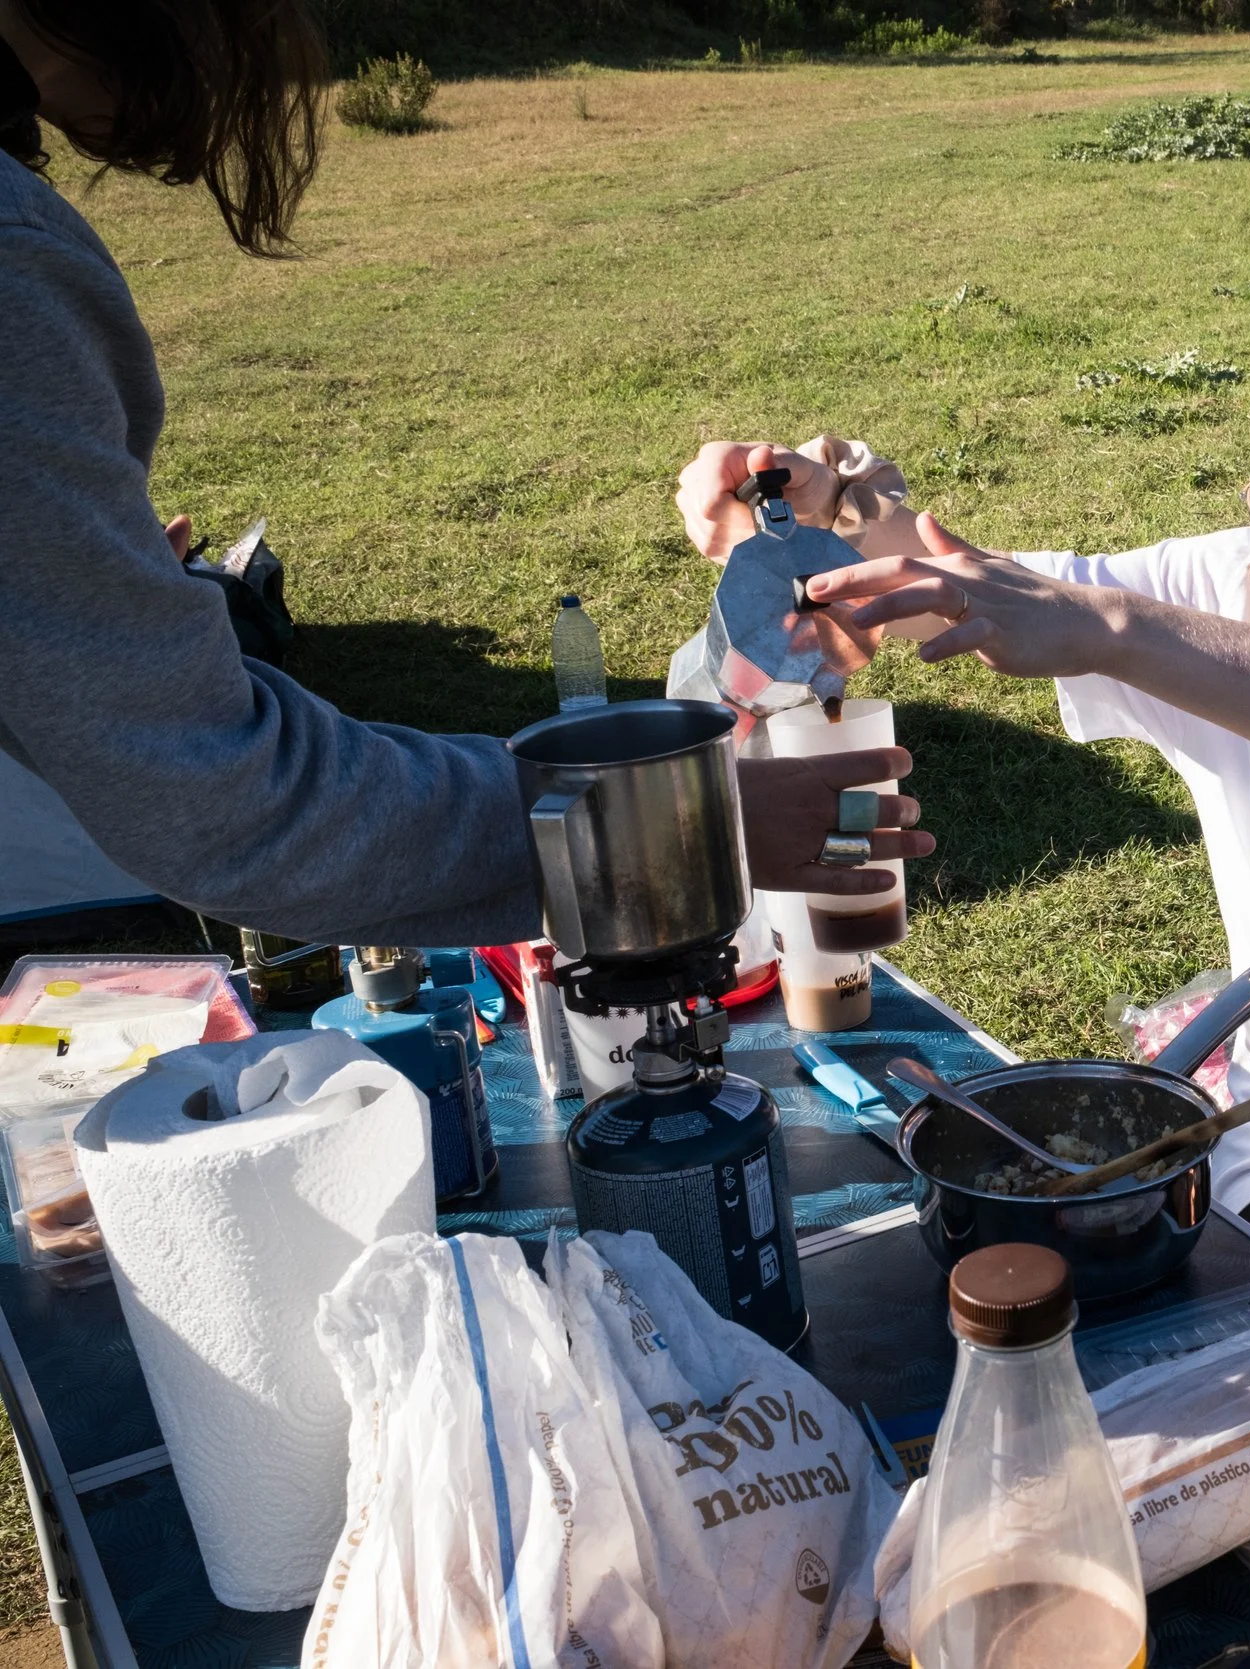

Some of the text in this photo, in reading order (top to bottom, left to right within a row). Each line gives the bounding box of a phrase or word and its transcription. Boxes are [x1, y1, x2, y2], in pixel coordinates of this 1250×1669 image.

[693, 1452, 850, 1530] natural
[1143, 1462, 1250, 1518] libre de plástico
